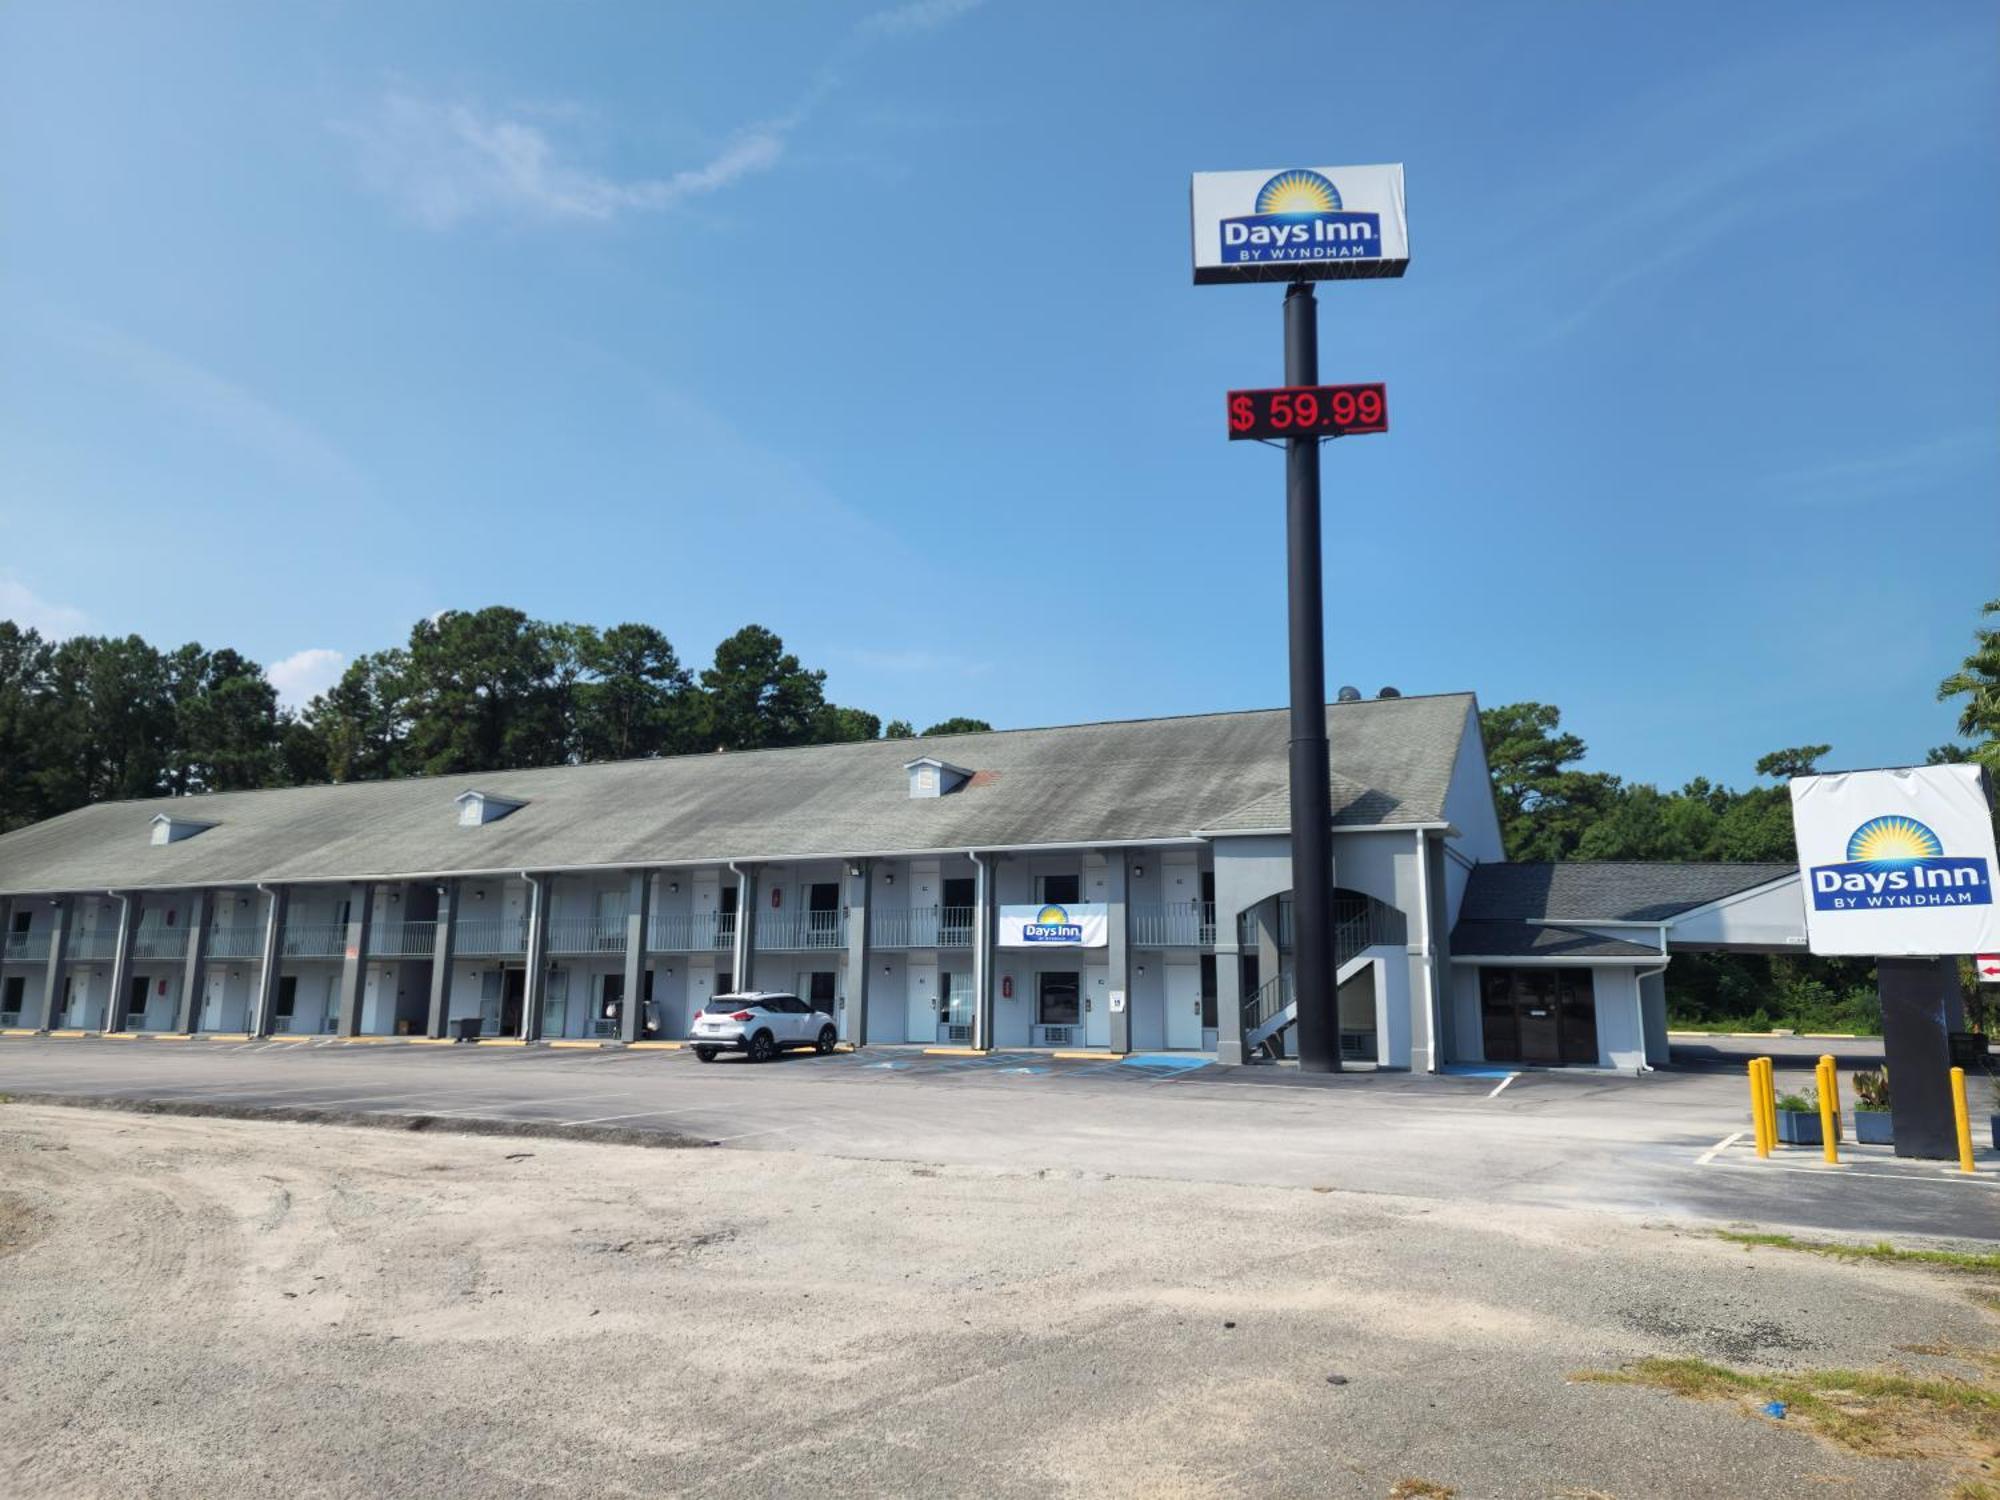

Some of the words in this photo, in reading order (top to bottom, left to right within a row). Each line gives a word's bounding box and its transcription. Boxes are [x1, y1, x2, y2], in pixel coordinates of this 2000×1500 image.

[1225, 223, 1310, 247] Days
[1315, 219, 1372, 241] Inn
[1240, 250, 1261, 261] BY
[1271, 246, 1364, 260] WYNDHAM
[1232, 397, 1255, 432] $
[1270, 390, 1382, 428] 59.99
[1816, 870, 1909, 894] Days
[1913, 866, 1979, 888] Inn
[1834, 897, 1857, 909] BY
[1867, 893, 1972, 907] WYNDHAM
[1026, 926, 1057, 936] Days
[1058, 925, 1079, 935] Inn
